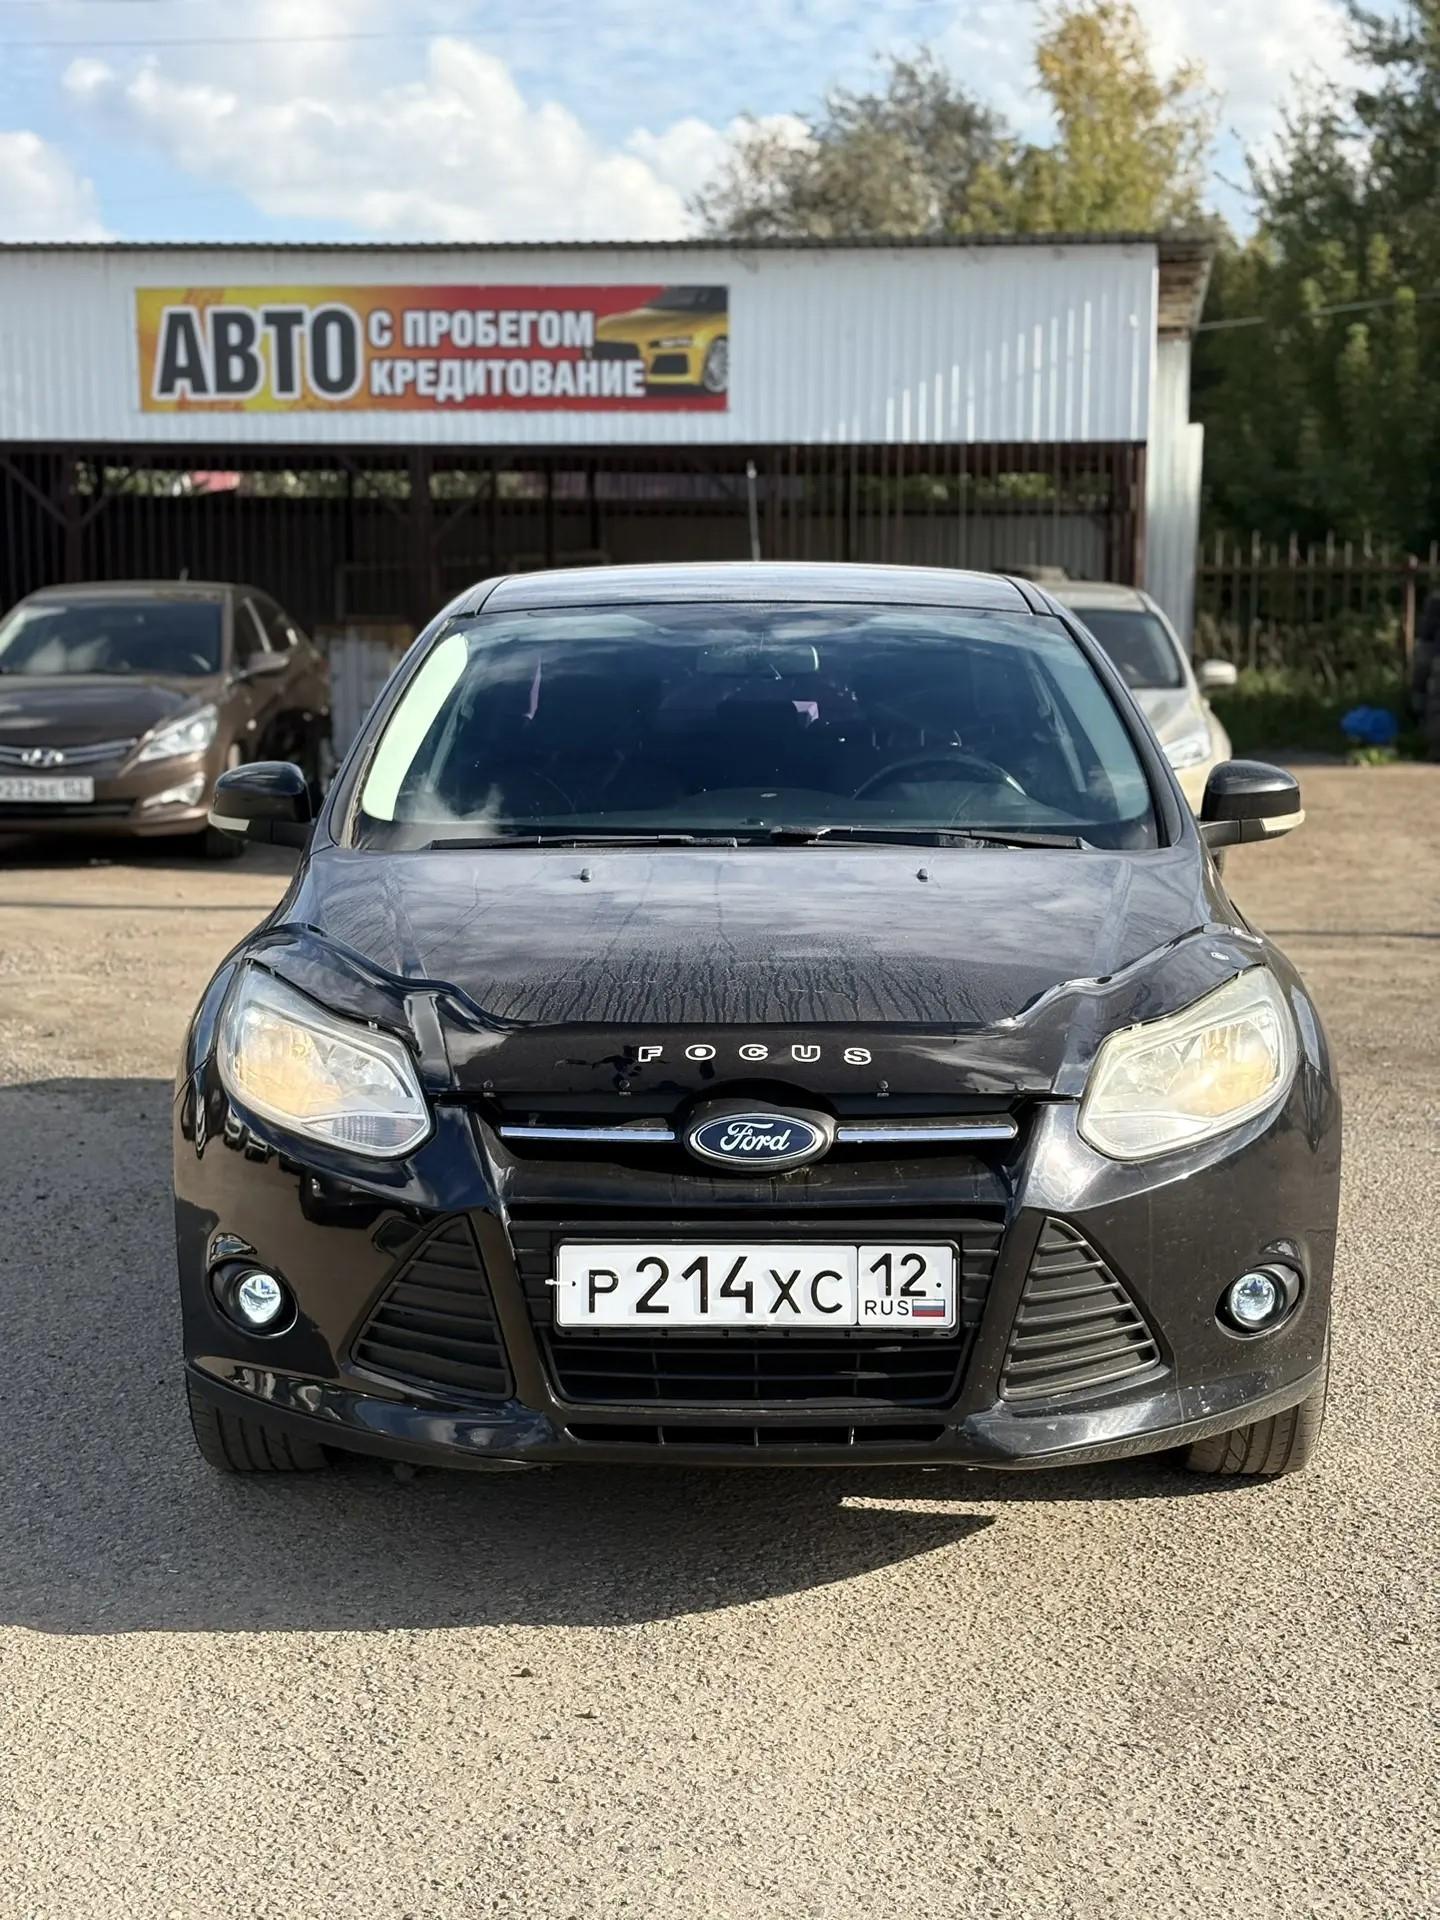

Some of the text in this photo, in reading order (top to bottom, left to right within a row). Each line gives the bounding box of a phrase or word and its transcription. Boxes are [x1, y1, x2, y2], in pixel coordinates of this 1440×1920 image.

[368, 309, 595, 348] С ПРОБЕГОМ
[156, 307, 360, 397] АВТО
[370, 359, 647, 402] КРЕДИТОВАНИЕ
[638, 1044, 872, 1065] FOCUS
[719, 1121, 792, 1151] Ford
[869, 1252, 928, 1297] 12
[864, 1299, 909, 1316] RUS
